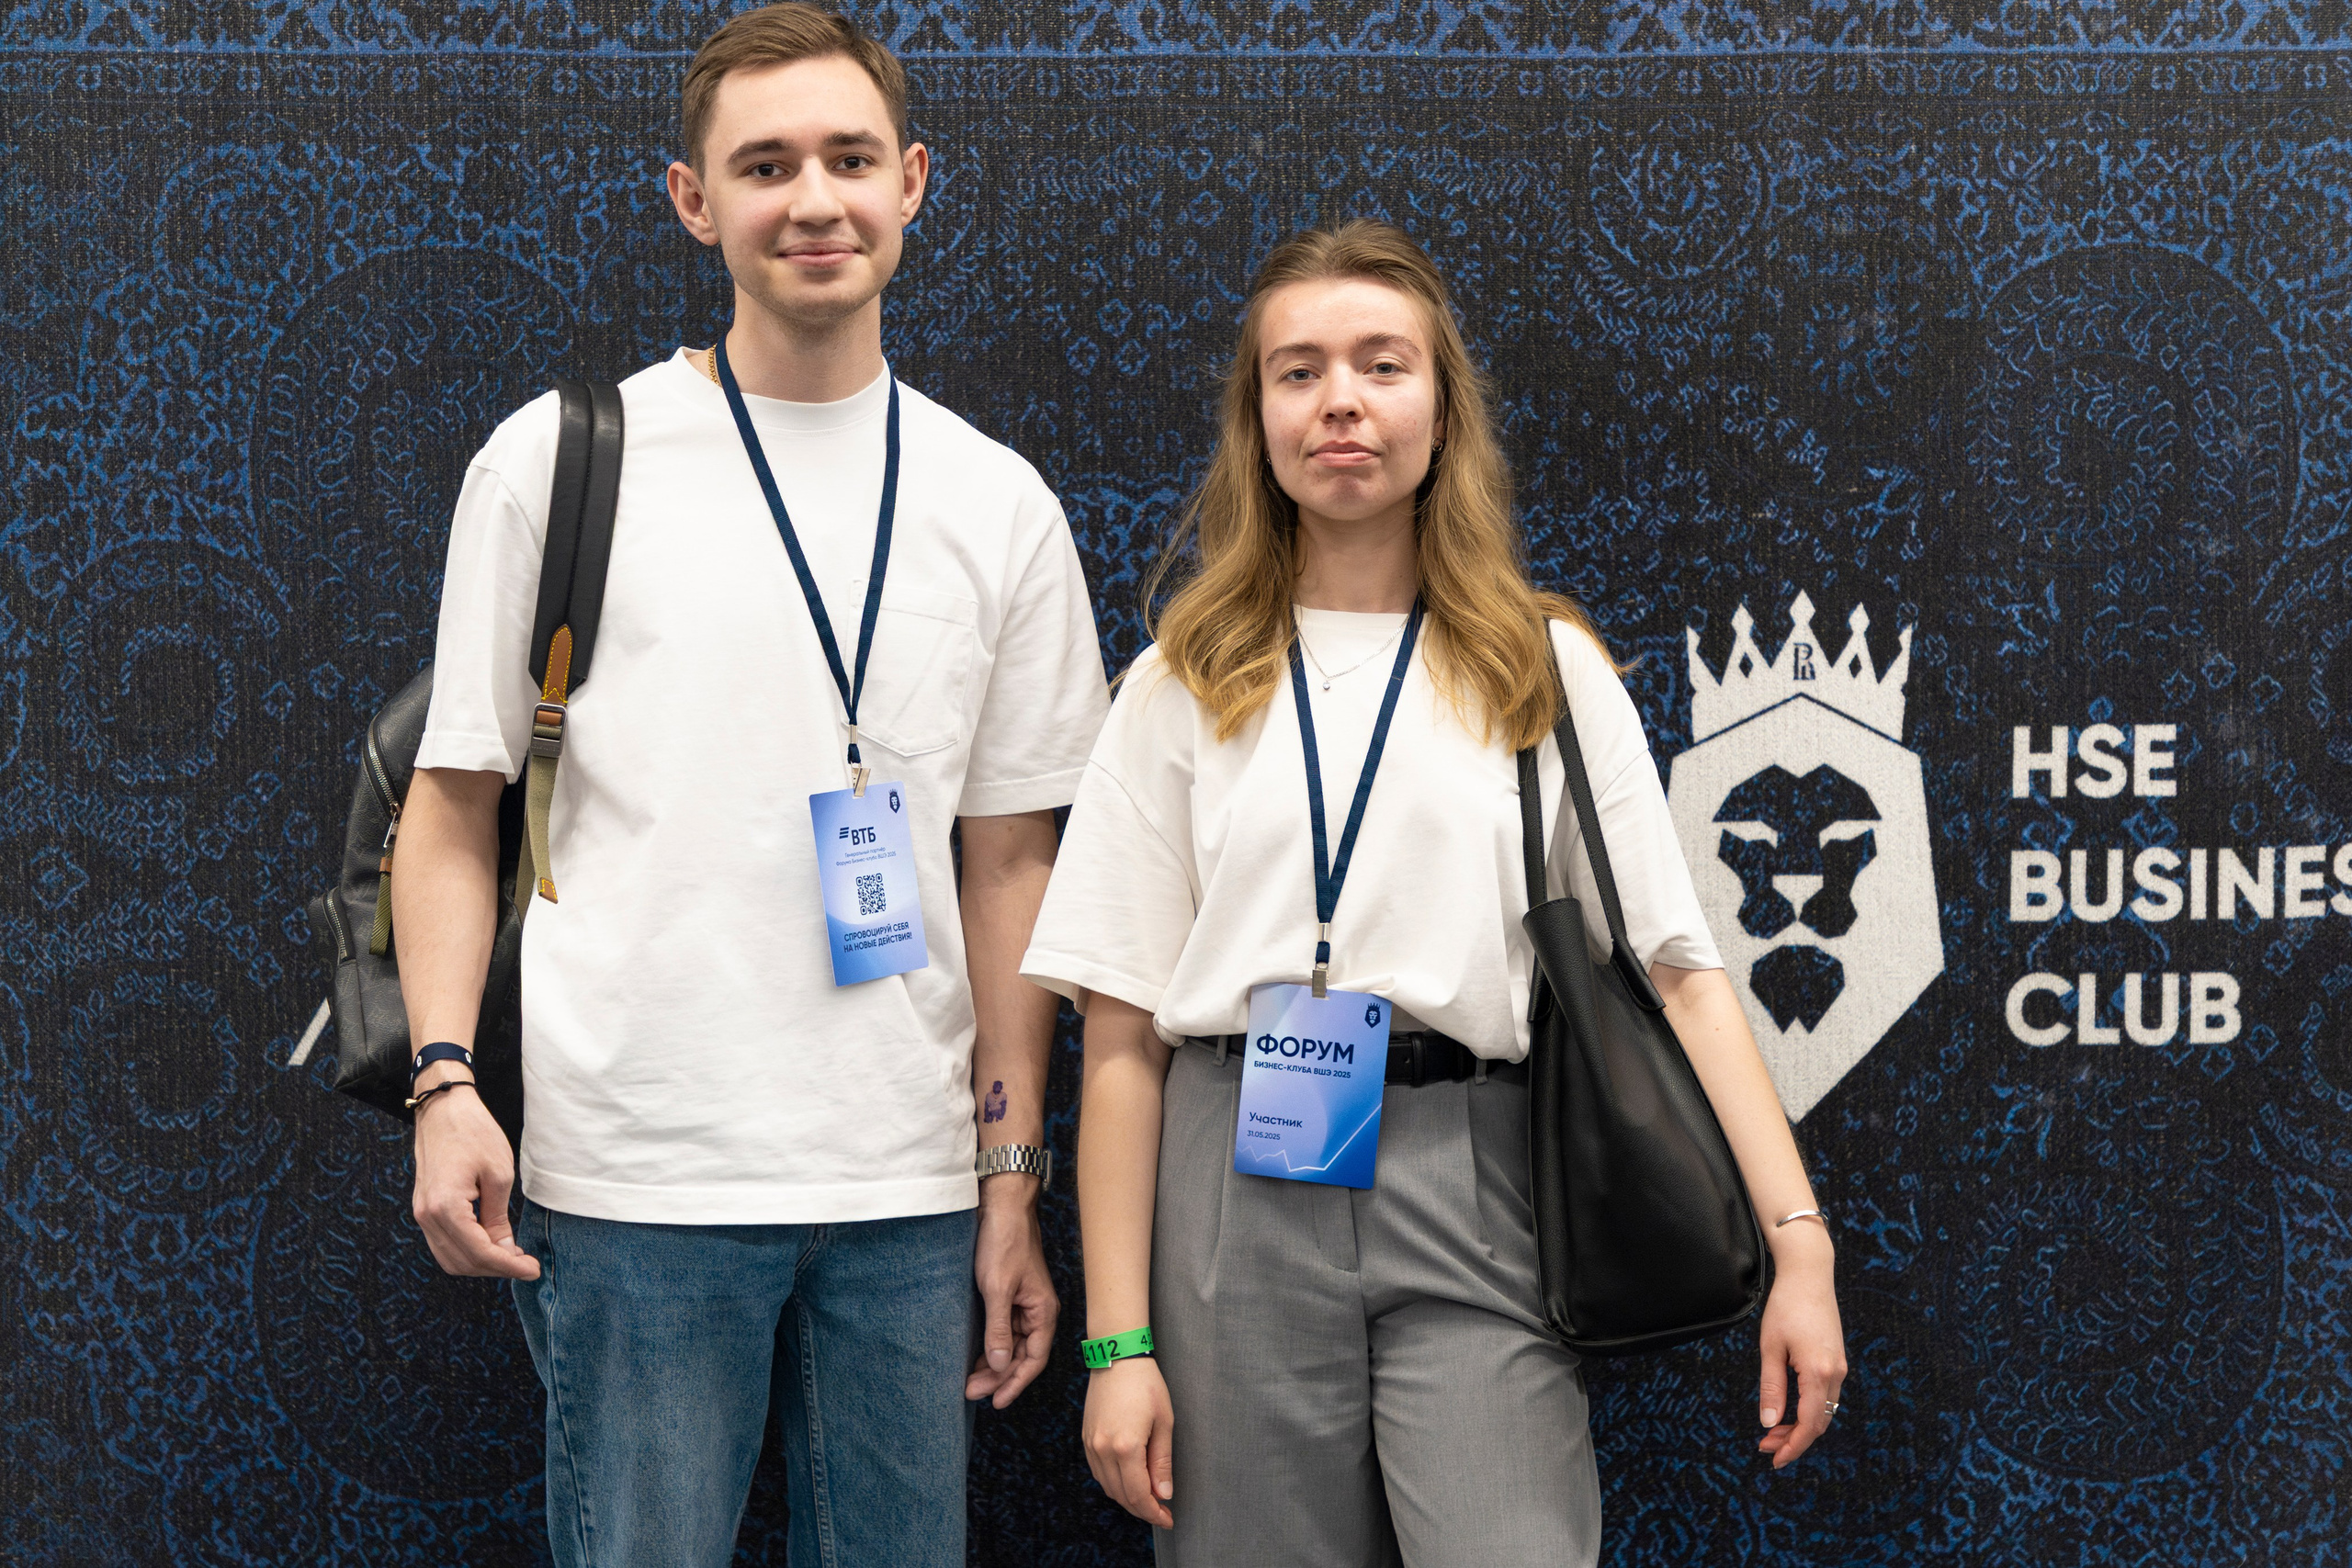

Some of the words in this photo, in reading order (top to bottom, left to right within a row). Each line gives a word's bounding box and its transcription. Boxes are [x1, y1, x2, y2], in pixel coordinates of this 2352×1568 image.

[2012, 724, 2177, 798] HSE
[851, 827, 876, 845] ВТБ
[843, 944, 854, 953] НА
[854, 940, 876, 951] НОВЫЕ
[878, 931, 912, 947] ДЕЙСТВИЯ!
[844, 924, 891, 942] СПРОВОЦИРУЙ
[893, 921, 909, 931] СЕБЯ
[2005, 972, 2242, 1046] CLUB
[1256, 1033, 1354, 1065] ФОРУМ
[1254, 1060, 1312, 1074] БИЗНЕС-КЛУБА
[1314, 1067, 1331, 1076] ВШЭ
[1333, 1070, 1351, 1078] 2025
[1250, 1111, 1303, 1128] Участник
[1247, 1130, 1281, 1141] 31.05.2025
